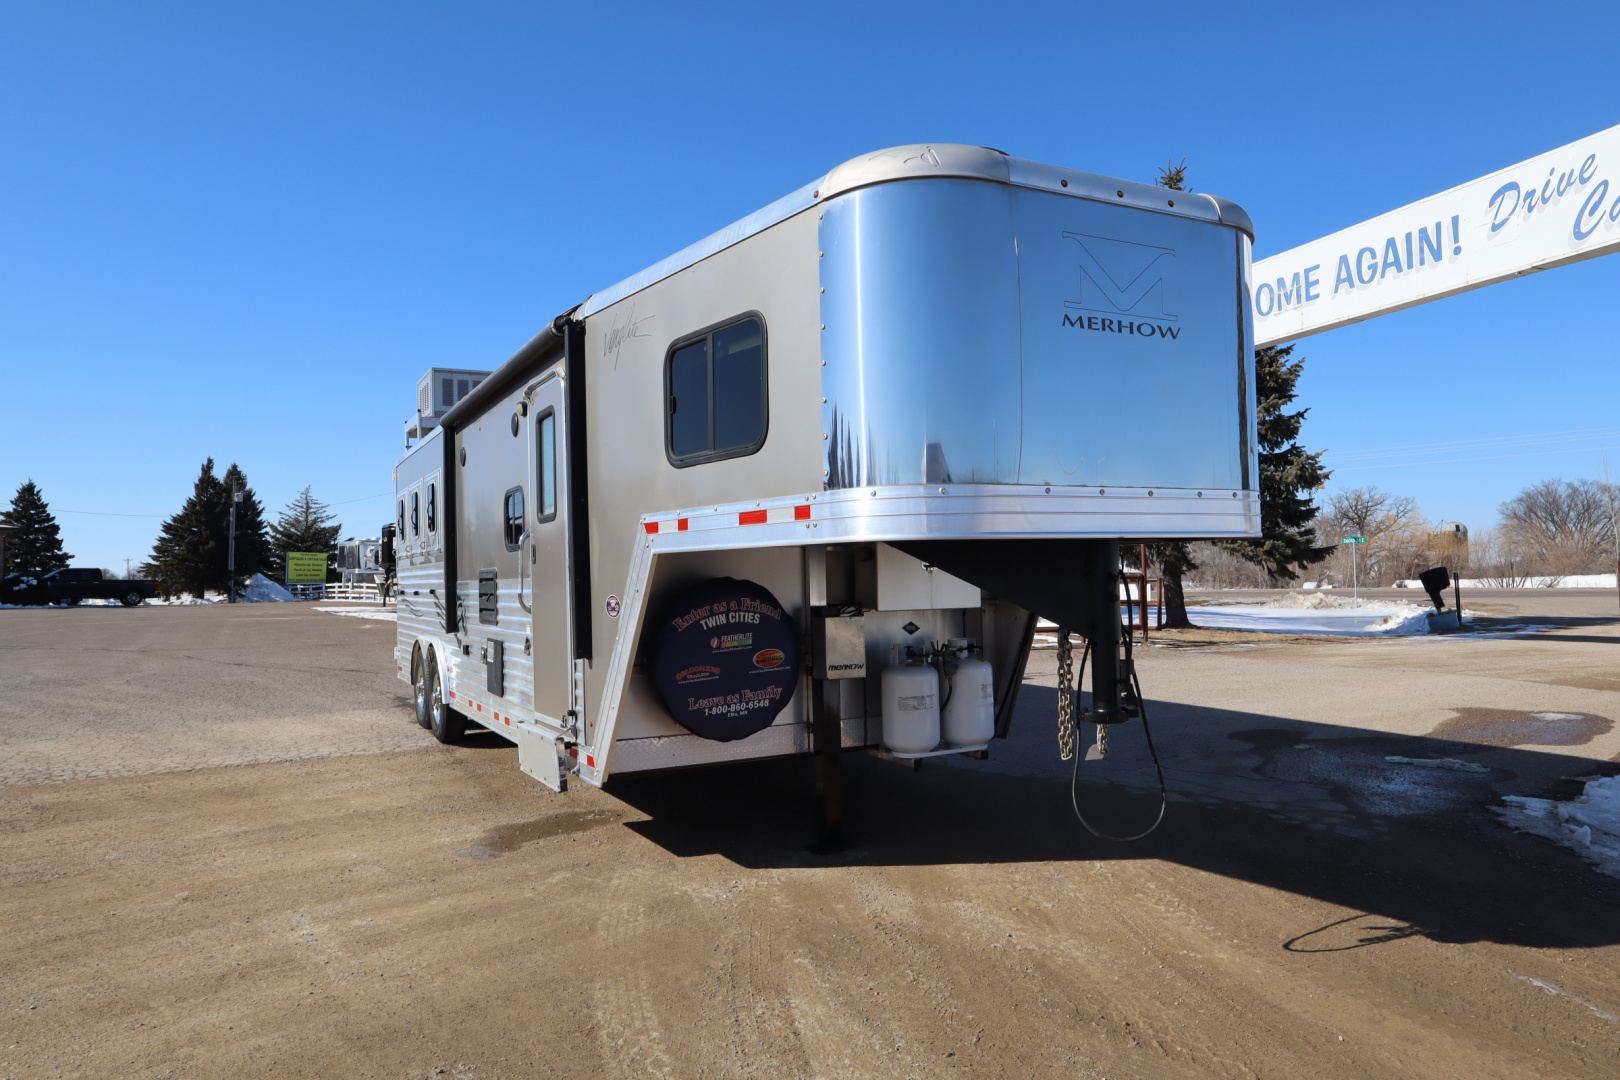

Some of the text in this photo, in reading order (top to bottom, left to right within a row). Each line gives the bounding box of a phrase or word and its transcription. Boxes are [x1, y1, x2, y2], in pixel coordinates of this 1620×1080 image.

[1489, 153, 1598, 233] Drive
[1334, 214, 1462, 295] AGAIN!
[1062, 313, 1181, 340] MERHOW
[672, 597, 782, 632] Enter as a Friend
[700, 612, 761, 630] TWIN CITIES
[721, 632, 753, 642] FEATHERLITE
[688, 685, 783, 710] Leave as Family
[704, 699, 769, 716] 1-800-860-6548
